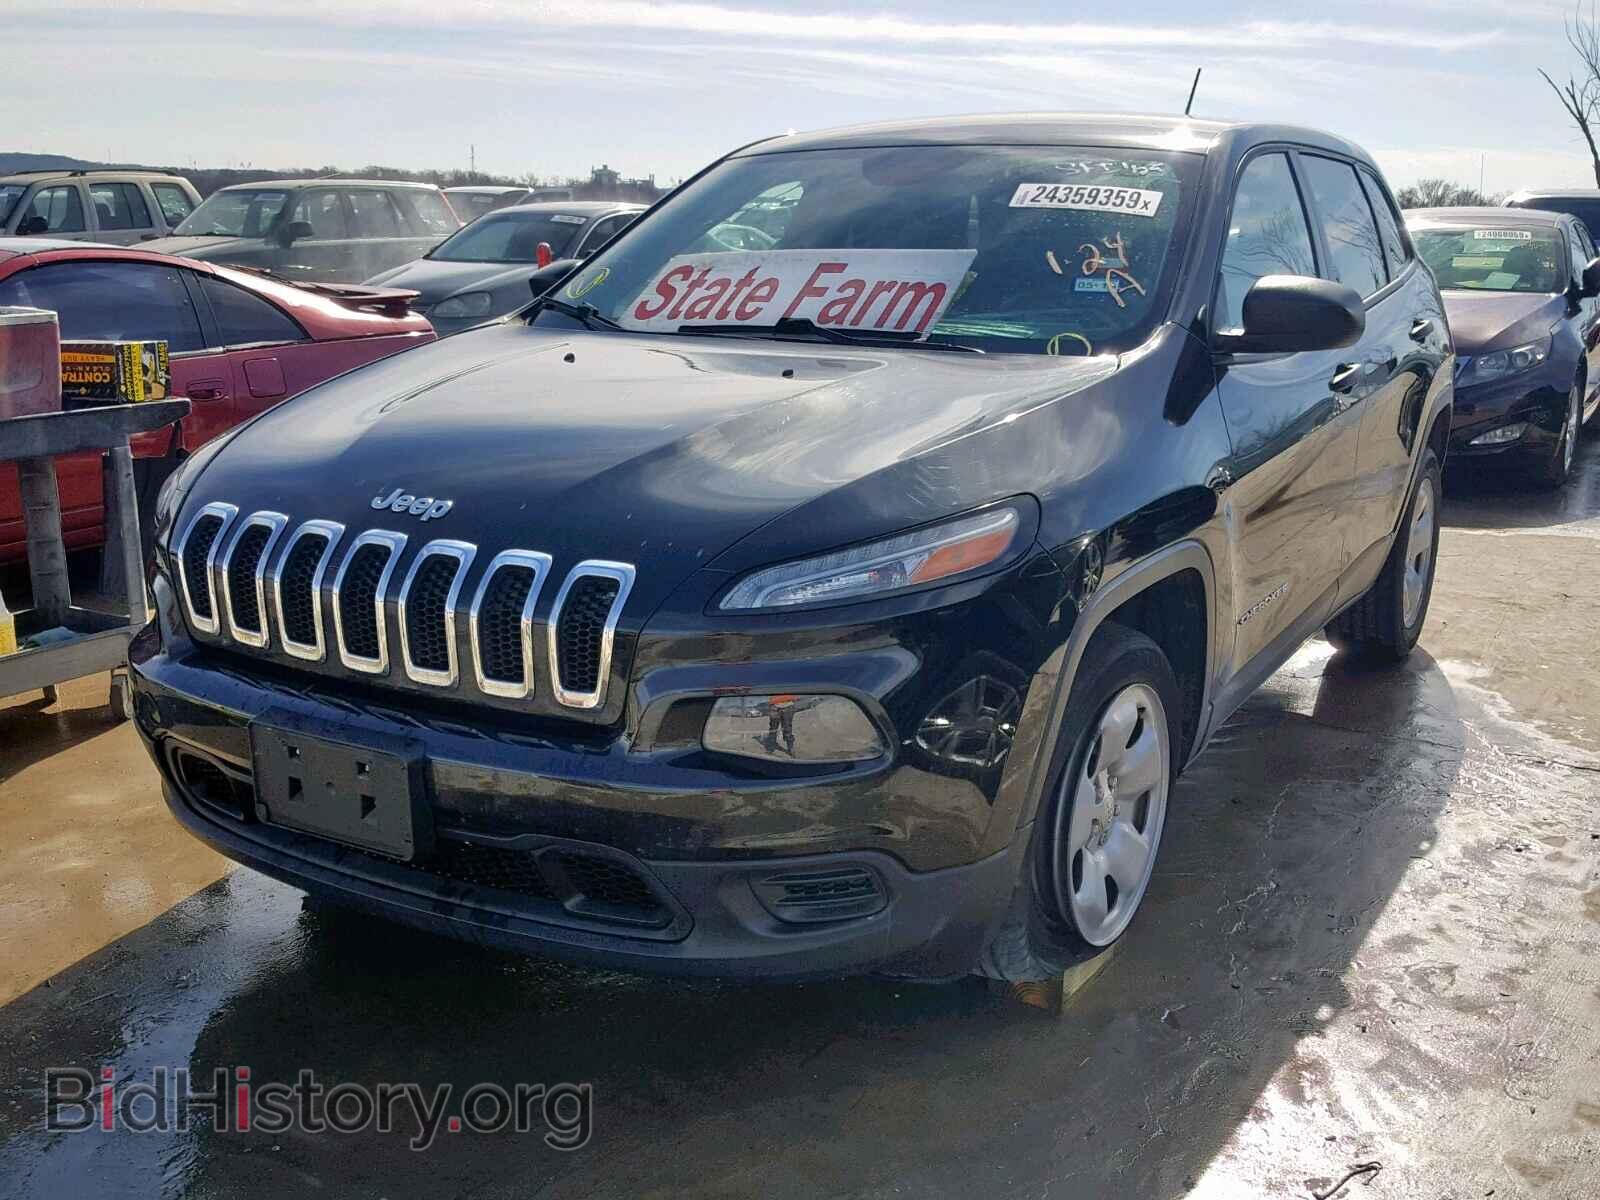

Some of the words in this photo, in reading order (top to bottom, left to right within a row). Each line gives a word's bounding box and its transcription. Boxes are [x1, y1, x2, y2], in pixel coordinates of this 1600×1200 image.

[633, 264, 780, 322] State
[781, 262, 948, 333] Farm
[371, 488, 454, 522] Jeep
